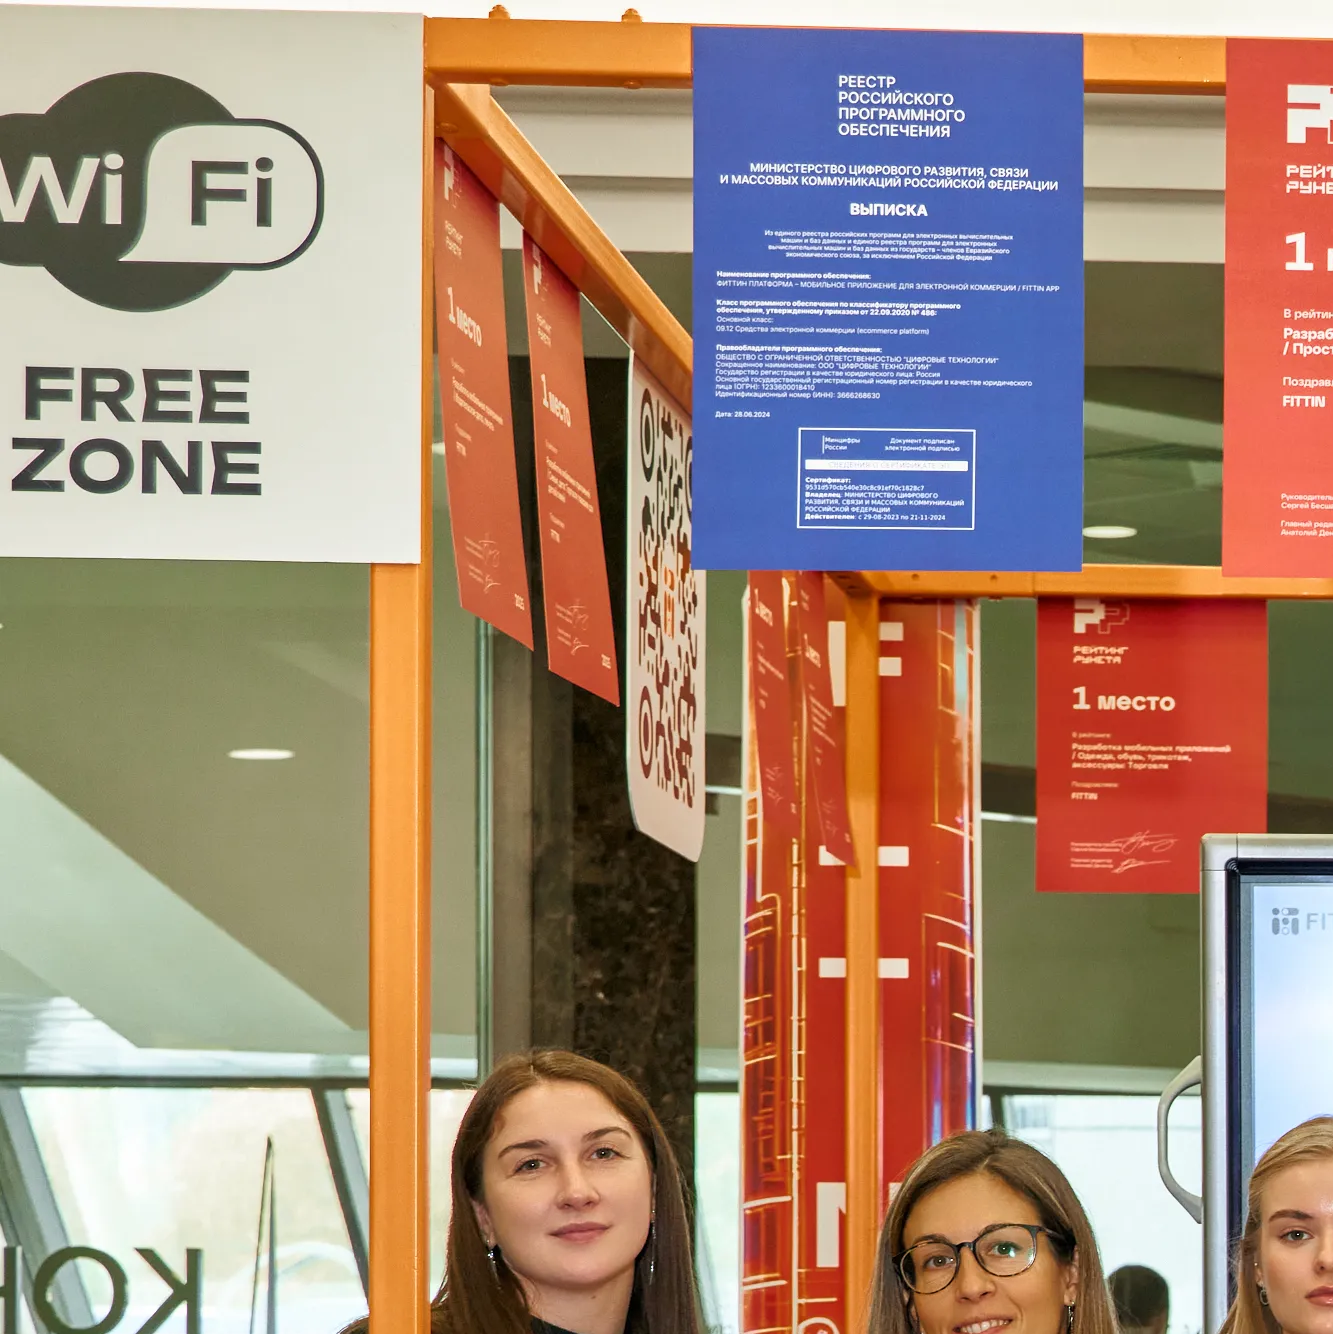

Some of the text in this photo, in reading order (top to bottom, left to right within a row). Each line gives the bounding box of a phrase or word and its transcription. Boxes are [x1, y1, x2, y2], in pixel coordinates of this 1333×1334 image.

[838, 74, 895, 88] РЕЕСТР
[838, 91, 953, 105] РОССИЙСКОГО
[838, 107, 965, 121] ПРОГРАММНОГО
[838, 122, 950, 137] ОБЕСПЕЧЕНИЯ
[750, 162, 1028, 179] МИНИСТЕРСТВО ЦИФРОВОГО РАЗВИТИЯ, СВЯЗИ
[0, 153, 274, 227] Wi Fi
[720, 174, 1057, 191] И МАССОВЫХ КОММУНИКАЦИЙ РОССИЙСКОЙ ФЕДЕРАЦИИ
[850, 202, 927, 216] ВЫПИСКА
[1284, 231, 1313, 270] 1
[1283, 308, 1291, 318] В
[25, 366, 250, 425] FREE
[1282, 395, 1325, 407] FITTIN
[11, 437, 262, 497] ZONE
[1280, 501, 1309, 509] Сергей
[1072, 686, 1175, 711] 1 место
